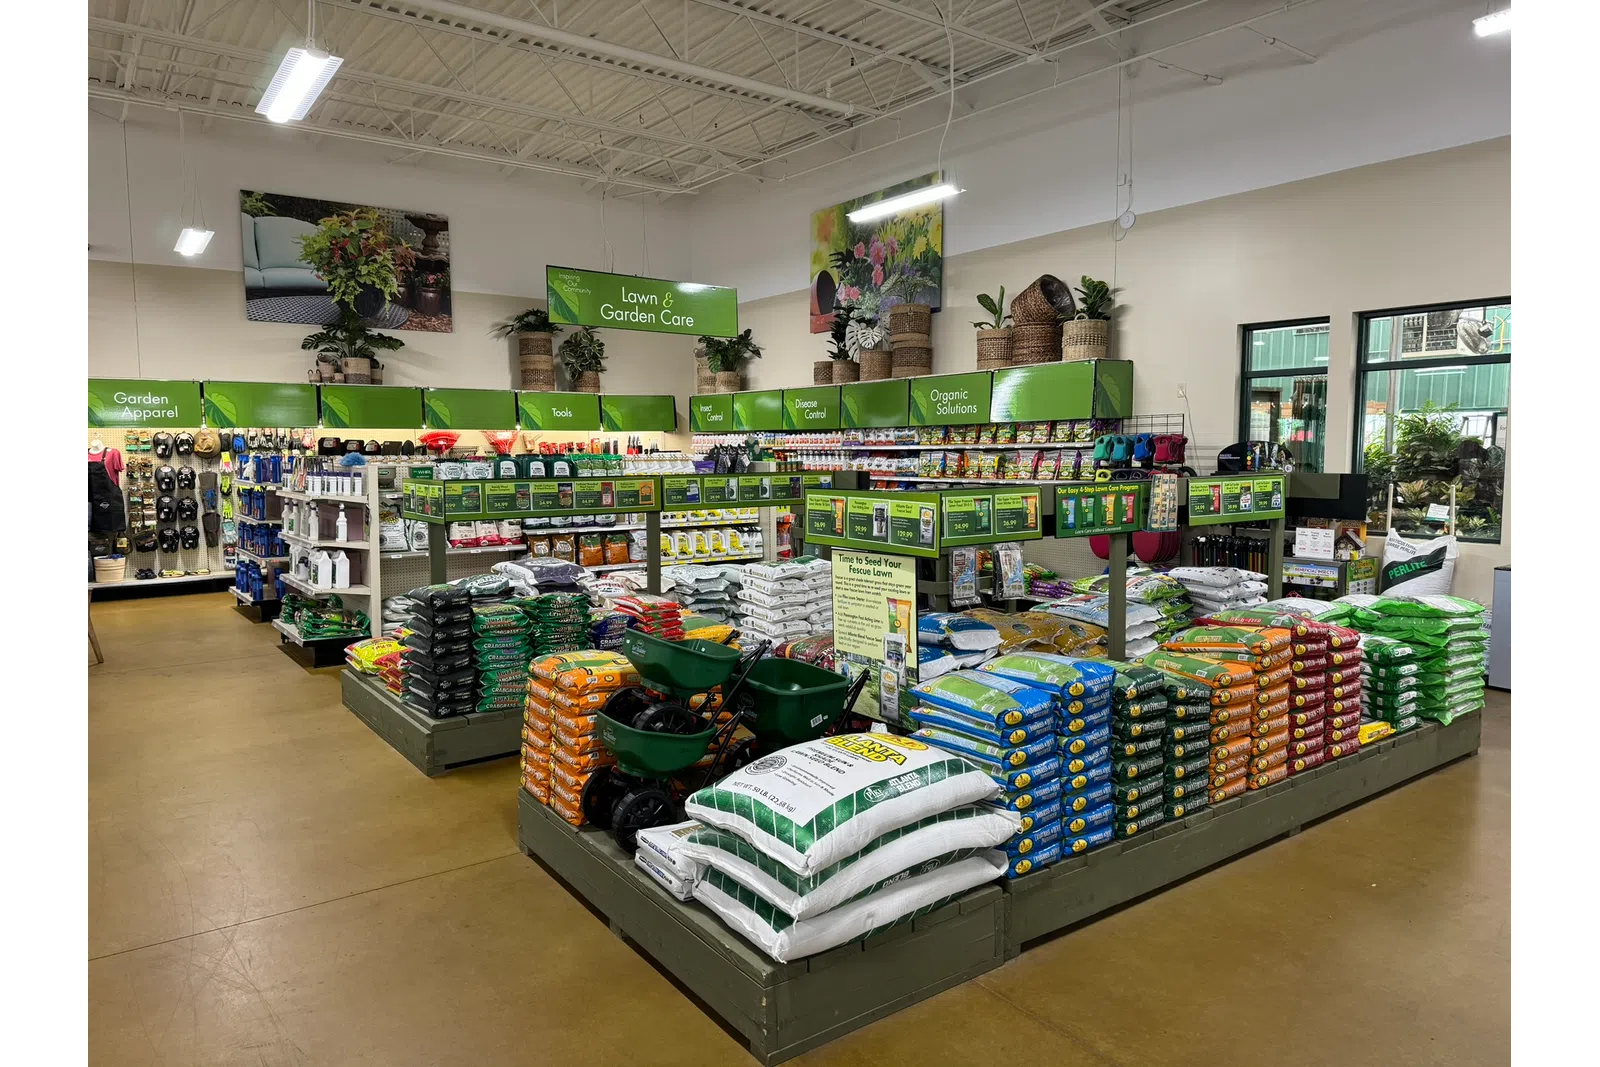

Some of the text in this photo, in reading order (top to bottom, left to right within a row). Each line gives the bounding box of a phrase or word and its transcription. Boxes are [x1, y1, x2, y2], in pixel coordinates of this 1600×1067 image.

[559, 272, 580, 282] Inspiring
[563, 284, 592, 295] Community
[622, 287, 674, 308] Lawn &
[600, 303, 694, 327] Garden Care
[114, 392, 169, 405] Garden
[930, 388, 968, 404] Organic
[700, 404, 712, 412] Insect
[795, 398, 818, 409] Disease
[936, 402, 978, 416] Solutions
[121, 406, 179, 421] Apparel
[552, 407, 573, 418] Tools
[706, 412, 724, 422] Control
[804, 407, 827, 419] Control
[1068, 486, 1079, 495] Easy
[897, 530, 913, 538] 129.99
[839, 554, 902, 568] Time to Seed Your
[849, 565, 892, 578] Fescue Lawn
[1388, 560, 1428, 580] PERLITE
[825, 737, 888, 762] BLEND
[807, 756, 824, 765] SEED
[823, 762, 846, 775] BLEND
[889, 772, 920, 787] ATLANTA
[897, 780, 921, 794] BLEND
[787, 803, 797, 813] kg)
[882, 870, 910, 888] BLEND
